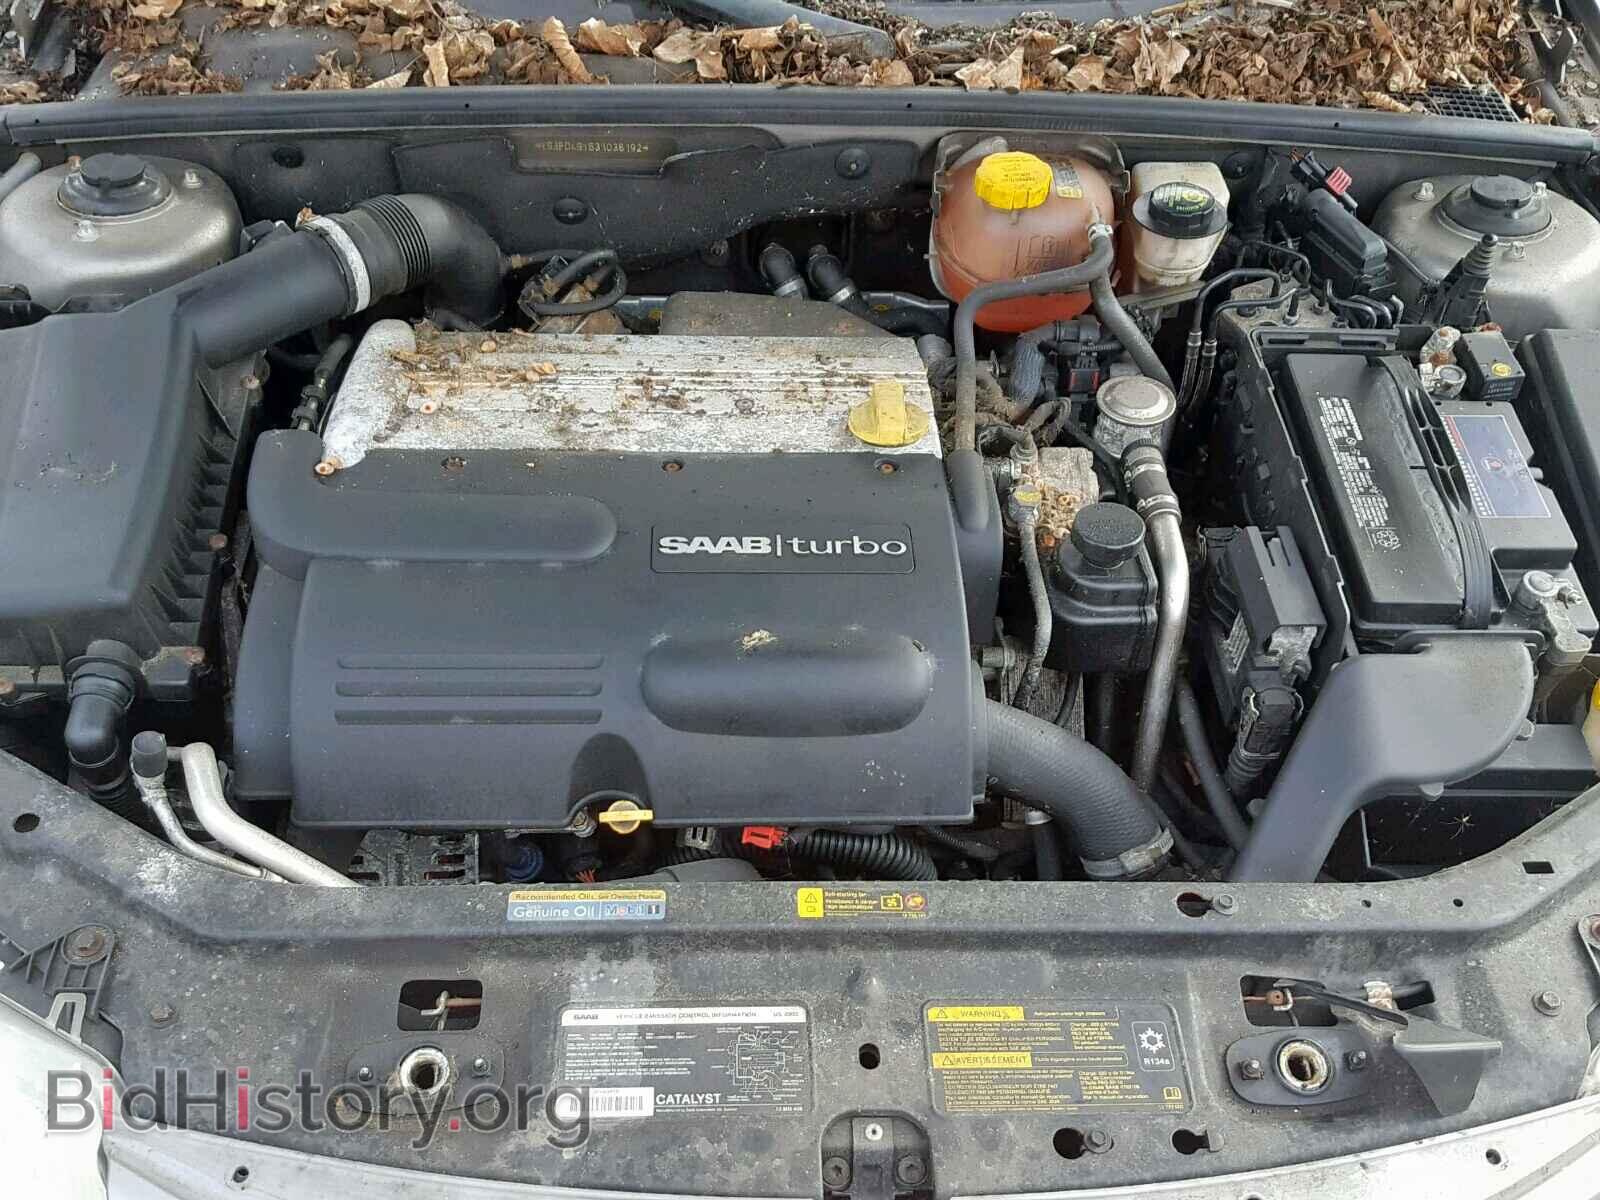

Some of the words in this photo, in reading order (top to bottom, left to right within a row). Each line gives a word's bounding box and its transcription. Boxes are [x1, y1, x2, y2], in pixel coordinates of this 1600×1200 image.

[658, 536, 772, 555] SAAB
[785, 535, 908, 556] turbo
[512, 905, 570, 918] Genuine
[573, 904, 595, 918] Oil
[959, 1008, 1004, 1018] WARNING
[1143, 1057, 1170, 1065] R134a
[656, 1093, 721, 1104] CATALYST
